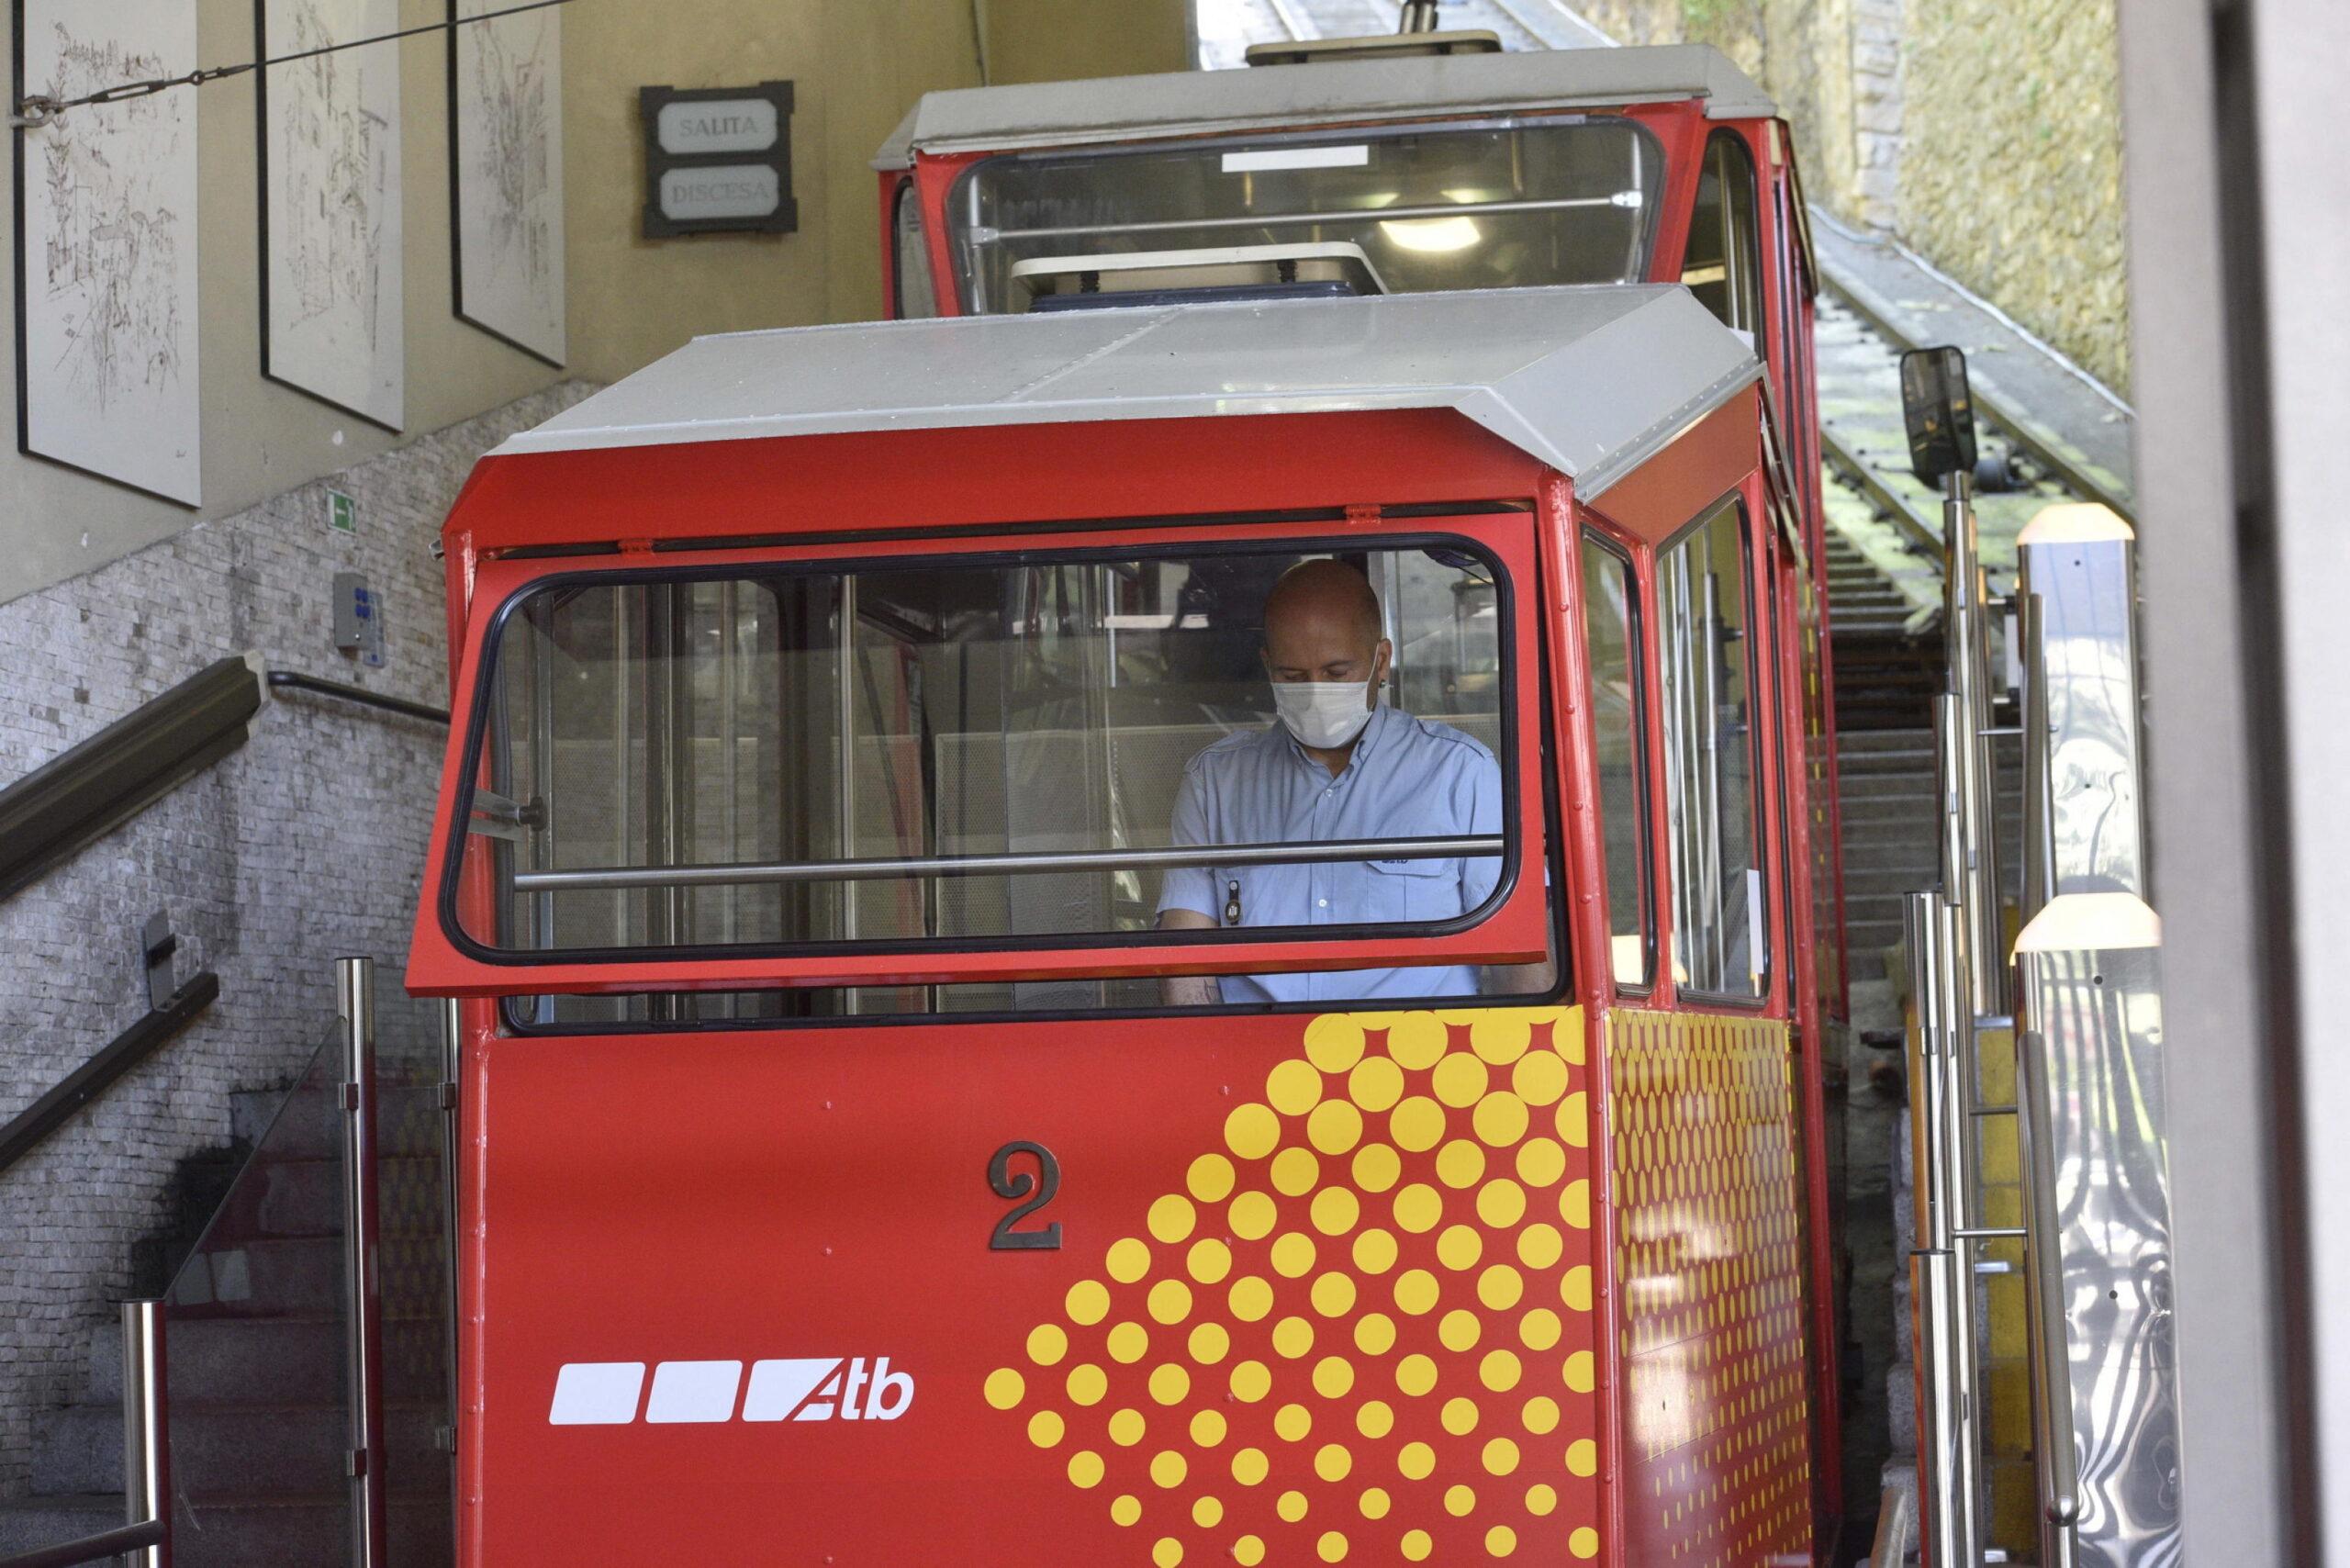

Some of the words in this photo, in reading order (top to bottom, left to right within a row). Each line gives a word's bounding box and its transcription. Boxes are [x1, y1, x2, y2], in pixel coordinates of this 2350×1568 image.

[679, 116, 758, 137] SALITA
[672, 181, 770, 204] DISCESA
[987, 1140, 1063, 1250] 2
[786, 1357, 915, 1422] Atb
